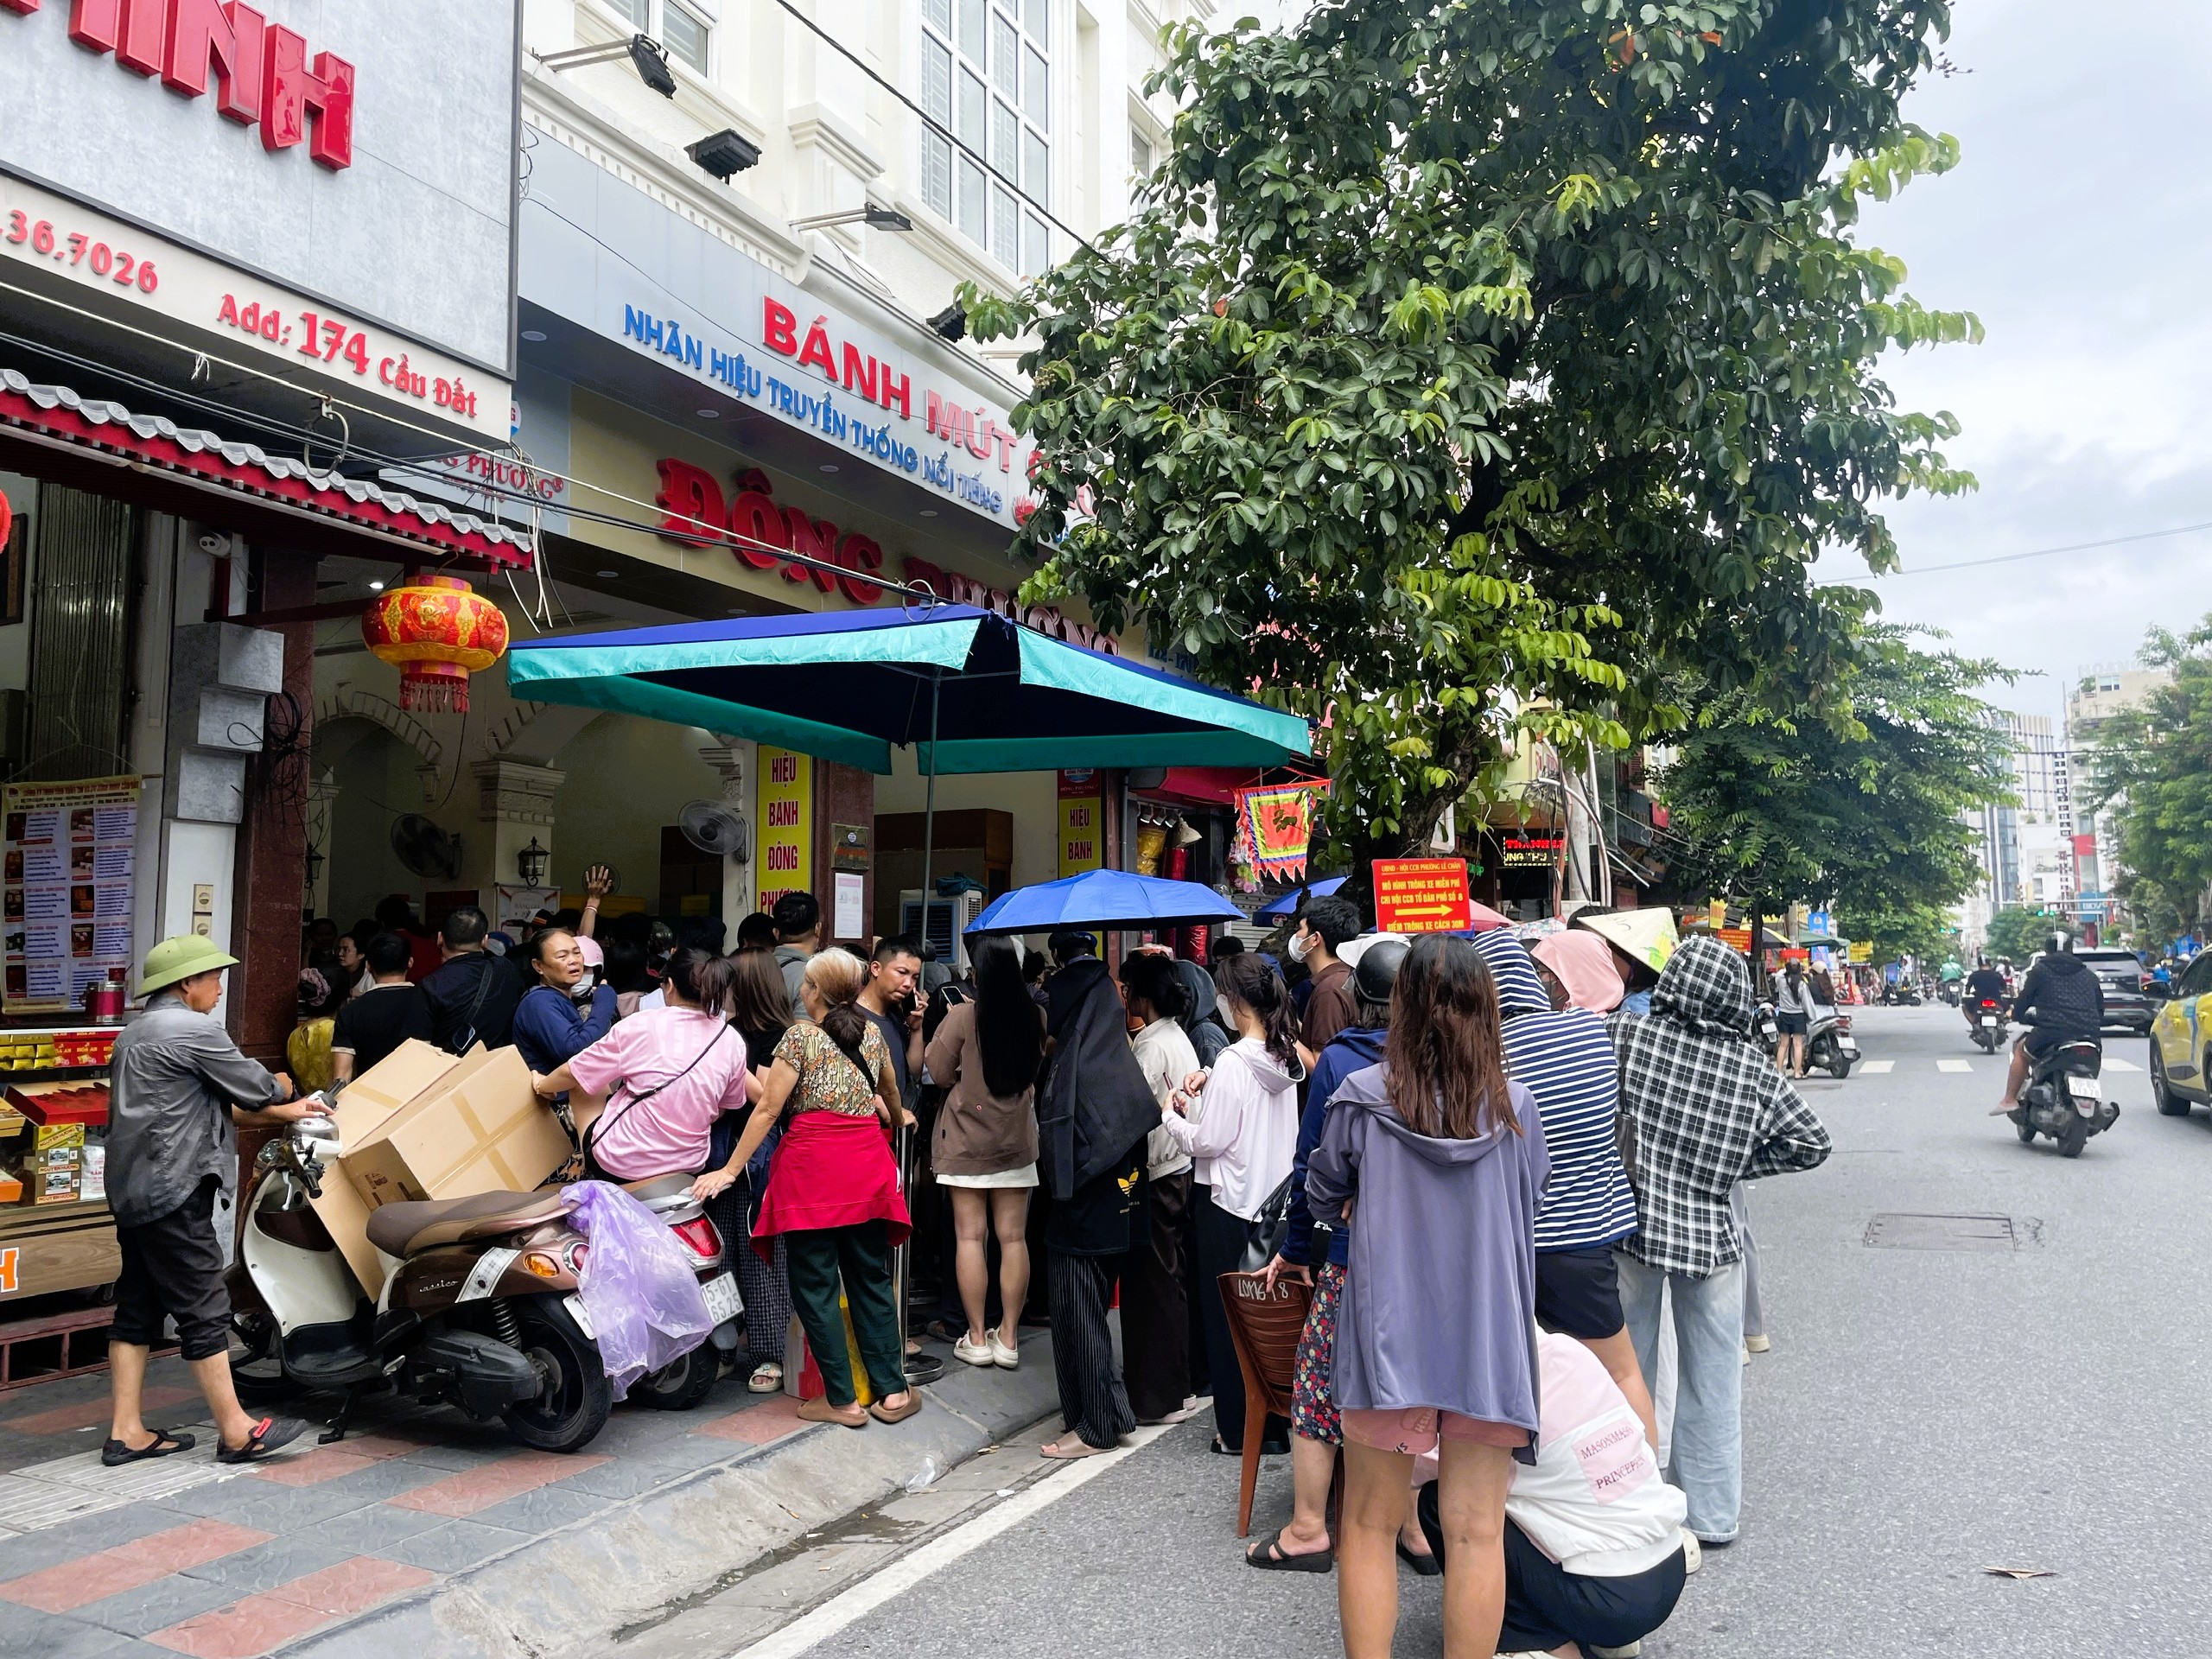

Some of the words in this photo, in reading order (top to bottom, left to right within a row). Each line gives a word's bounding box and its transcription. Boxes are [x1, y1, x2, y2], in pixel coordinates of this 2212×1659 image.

[217, 294, 292, 346] Add:
[297, 311, 370, 375] 174
[378, 353, 426, 398] Cầu
[433, 377, 477, 417] Đất
[762, 296, 911, 420] BÁNH
[623, 303, 702, 370] NHÃN
[709, 346, 761, 398] HIỆU
[766, 376, 846, 440] TRUYỀN
[850, 423, 918, 472] THỐNG
[922, 450, 954, 493] NỔI
[957, 471, 1003, 513] TIẾNG
[656, 457, 886, 605] ĐÔNG
[772, 752, 797, 787] HIỆU
[768, 797, 799, 827] BÁNH
[1070, 804, 1090, 830] HIỆU
[768, 841, 798, 871] ĐÔNG
[1068, 837, 1092, 860] BÁNH
[1381, 896, 1390, 905] CHI
[1426, 921, 1433, 930] XE
[1434, 919, 1450, 929] CÁCH
